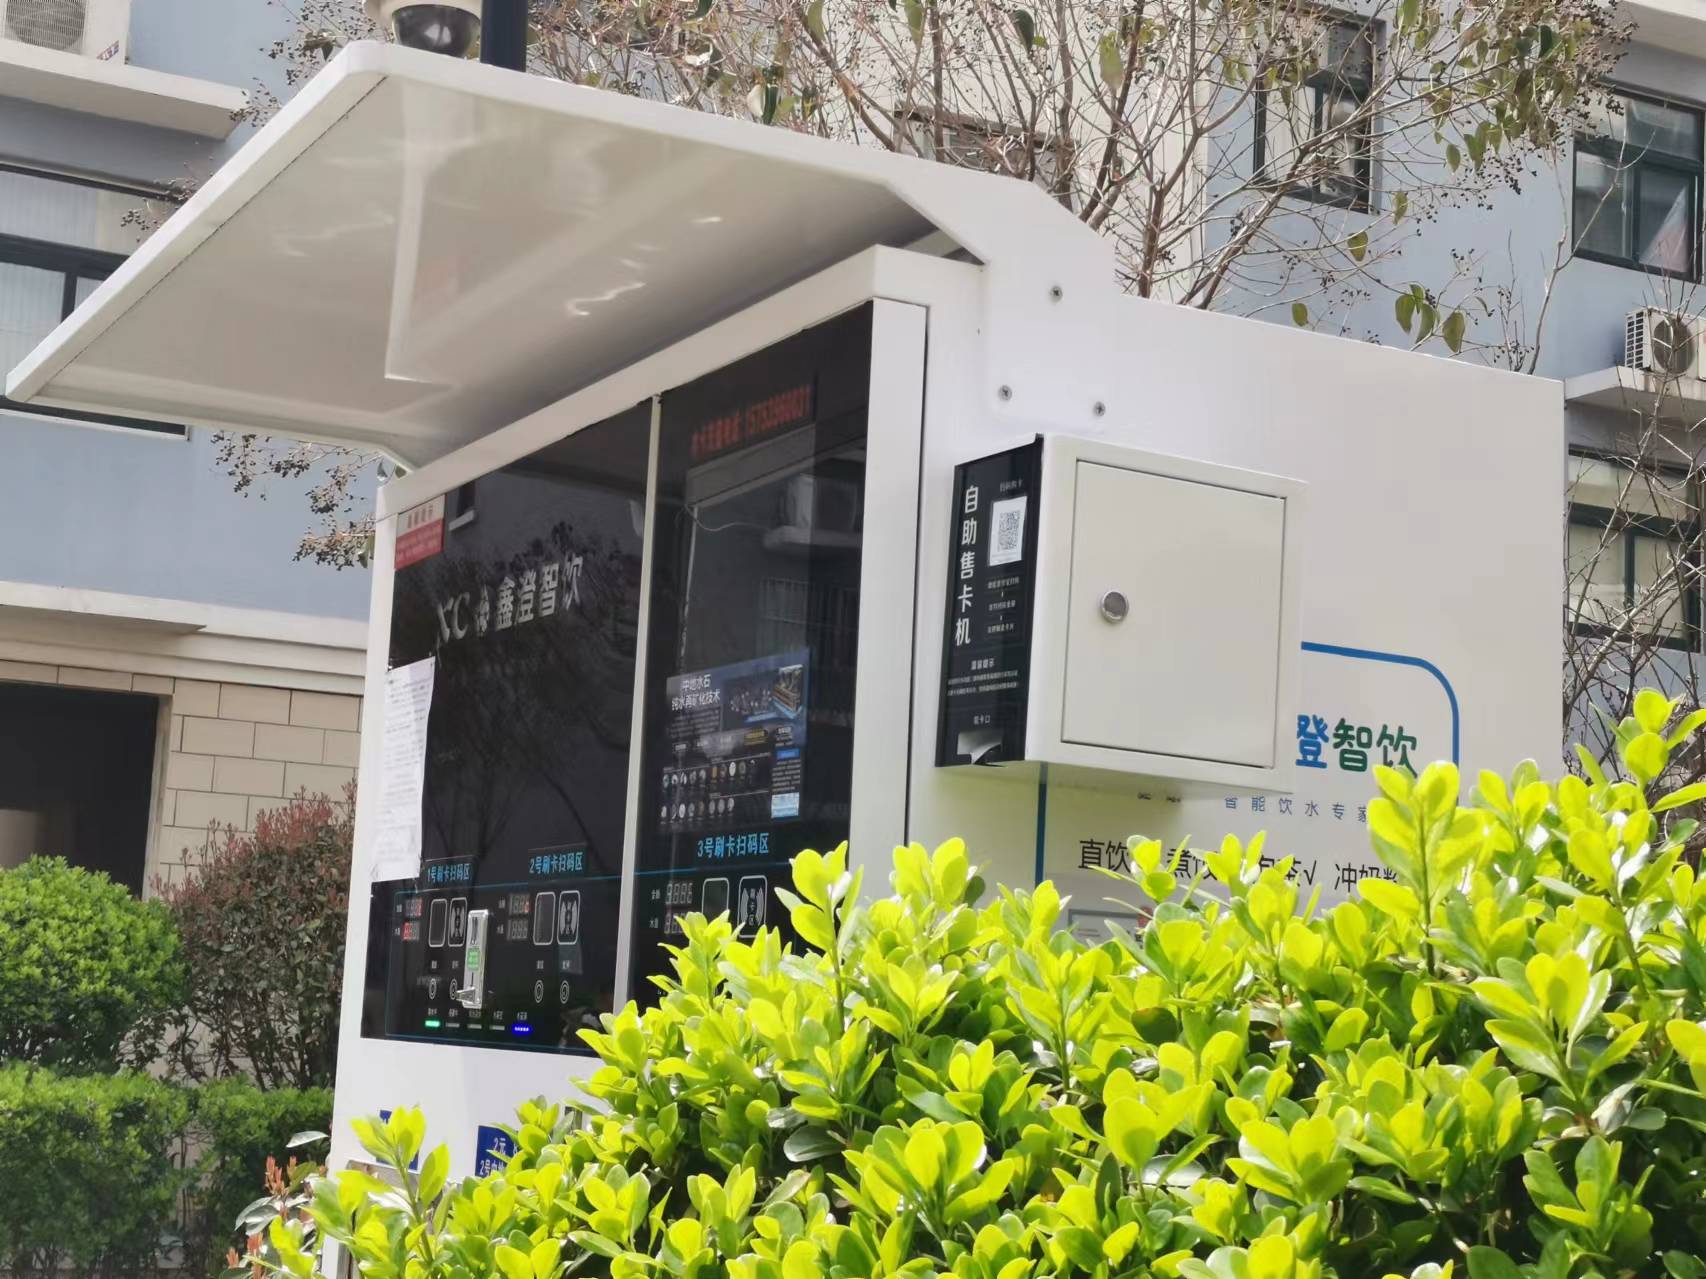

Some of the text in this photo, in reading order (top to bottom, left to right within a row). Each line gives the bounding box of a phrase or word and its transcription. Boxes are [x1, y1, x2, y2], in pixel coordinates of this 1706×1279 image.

[955, 486, 979, 647] 自助售卡机
[1295, 714, 1417, 777] 登智饮
[697, 832, 770, 858] 3号刷卡扫码区
[427, 863, 470, 883] 1号刷卡扫码区
[528, 851, 584, 875] 2号刷卡扫码区
